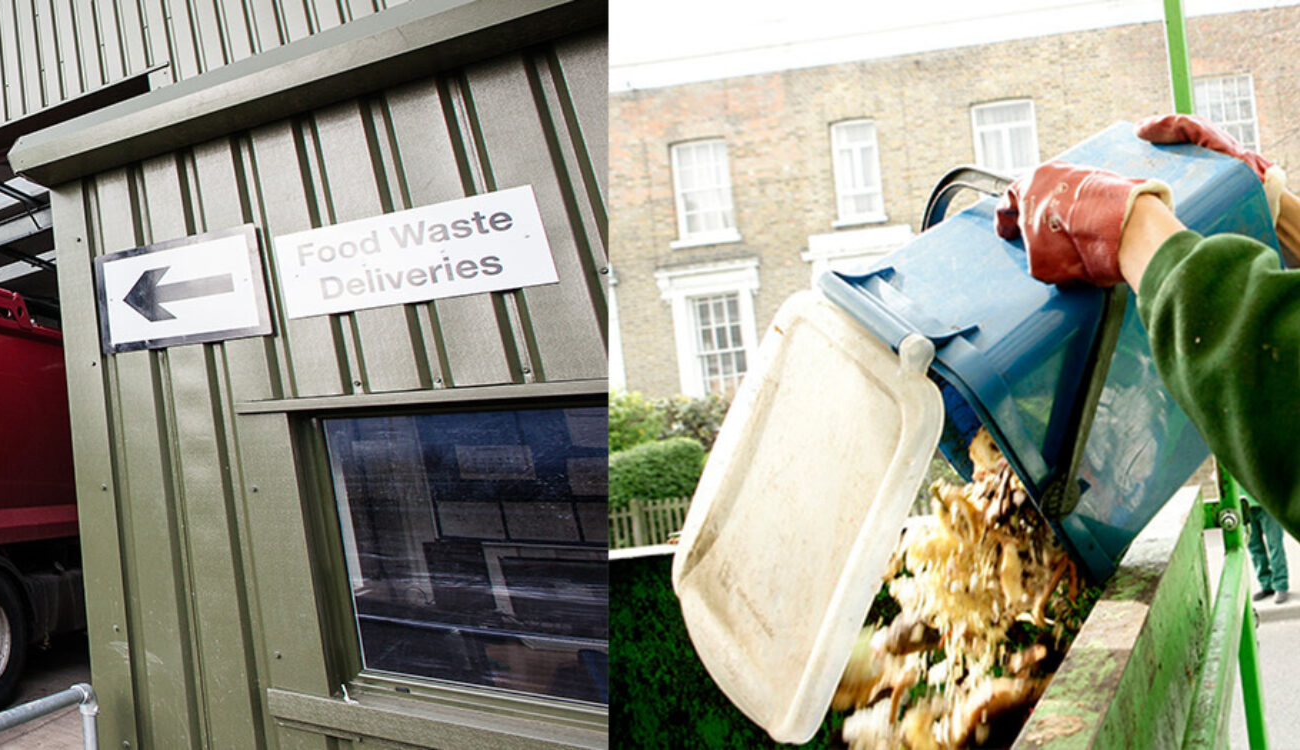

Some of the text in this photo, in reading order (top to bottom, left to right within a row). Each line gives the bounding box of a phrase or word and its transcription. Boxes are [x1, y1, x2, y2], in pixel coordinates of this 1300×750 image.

[297, 211, 513, 267] Food Waste
[320, 255, 503, 300] Deliveries
